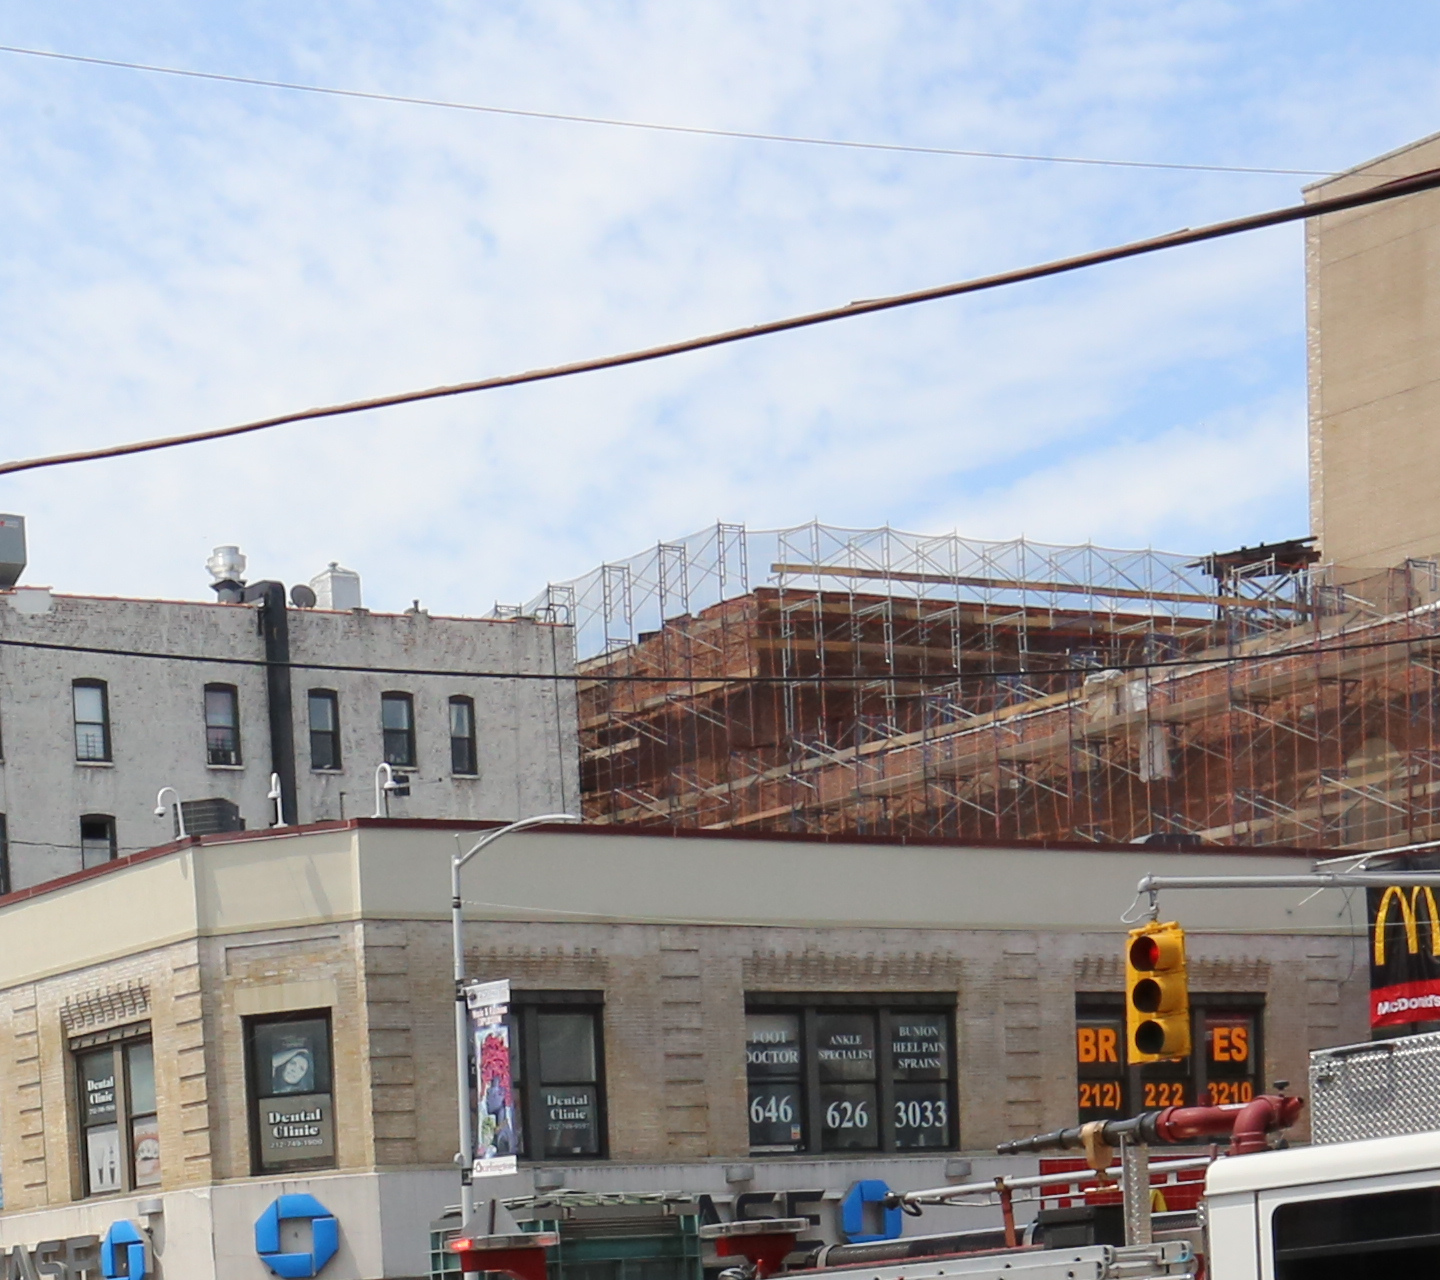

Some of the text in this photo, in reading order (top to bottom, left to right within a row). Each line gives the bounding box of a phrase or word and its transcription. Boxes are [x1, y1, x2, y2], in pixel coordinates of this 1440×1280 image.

[898, 1025, 939, 1037] BUNION
[828, 1034, 863, 1046] ANKLE
[892, 1041, 946, 1053] HEEL PAIN
[817, 1049, 874, 1061] SPECIALIST
[898, 1057, 941, 1070] SPRAINS
[87, 1075, 115, 1092] Dental
[90, 1091, 115, 1106] Clinic
[546, 1093, 589, 1107] Dental
[1144, 1082, 1184, 1107] 222
[1206, 1081, 1253, 1106] 3210
[268, 1108, 322, 1125] Dental
[549, 1108, 587, 1121] Clinic
[749, 1094, 794, 1124] 646
[825, 1100, 869, 1129] 626
[893, 1100, 948, 1130] 3033
[272, 1124, 320, 1140] Clinic
